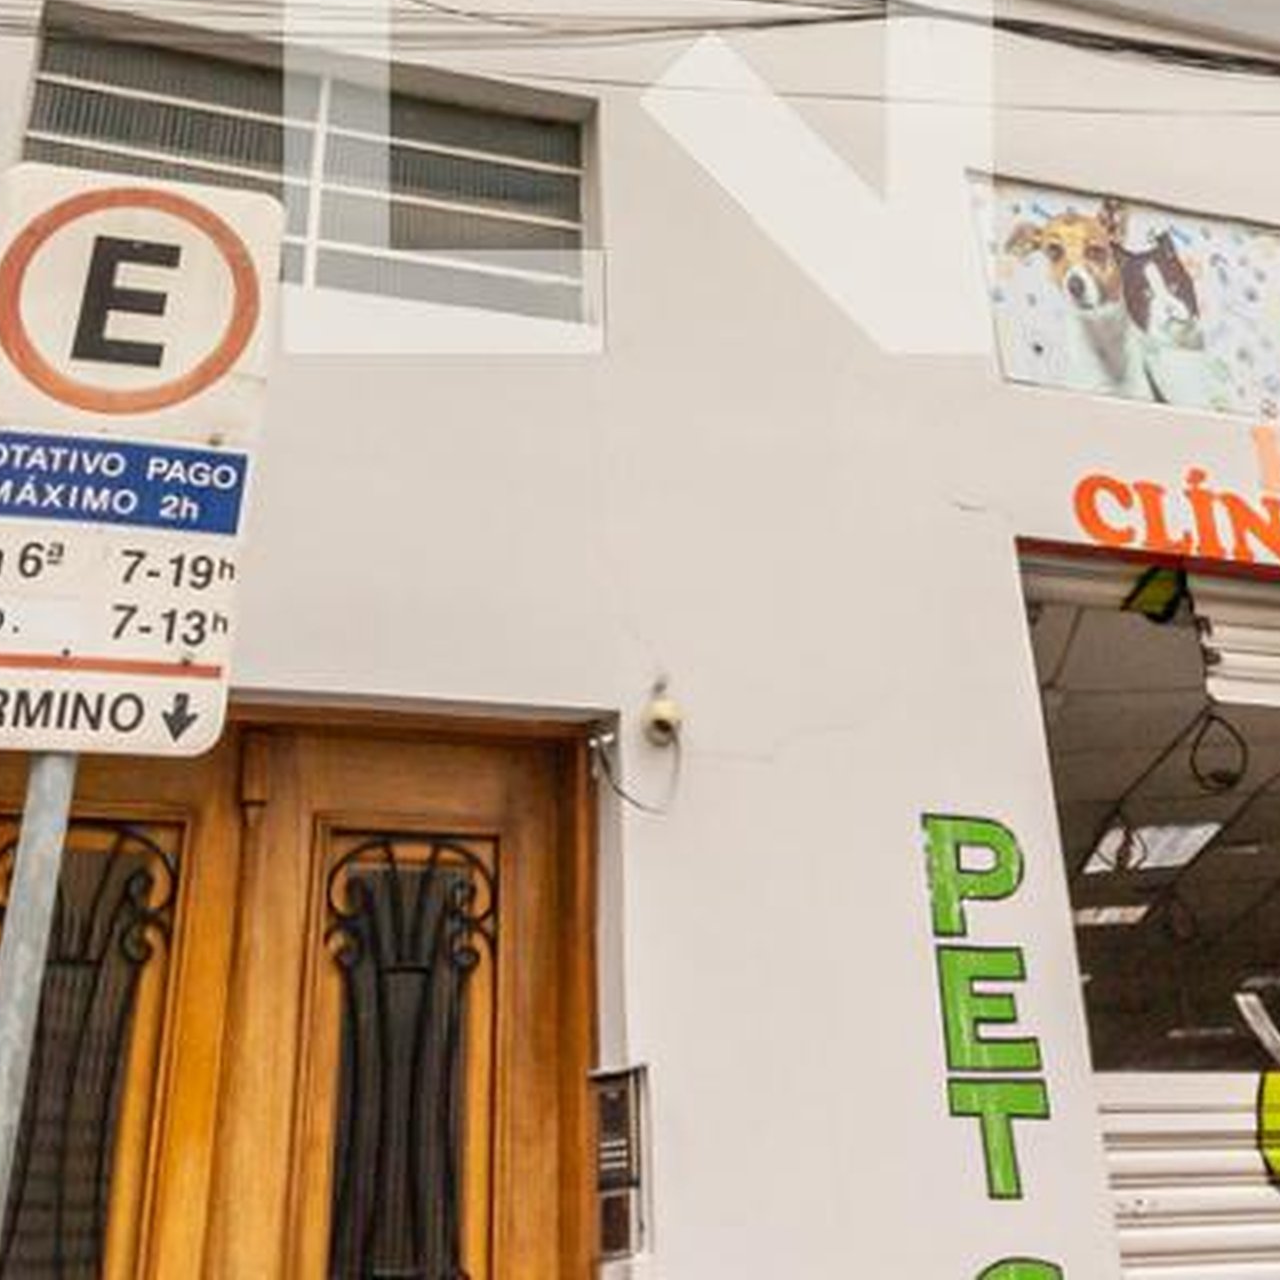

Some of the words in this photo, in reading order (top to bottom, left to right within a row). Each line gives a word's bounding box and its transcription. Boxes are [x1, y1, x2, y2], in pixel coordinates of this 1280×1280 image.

[70, 234, 182, 369] E
[145, 456, 238, 490] PAGO
[157, 495, 200, 522] 2h
[120, 548, 236, 591] 7-19h
[110, 603, 230, 648] 7-13h
[920, 812, 1051, 1201] PET
